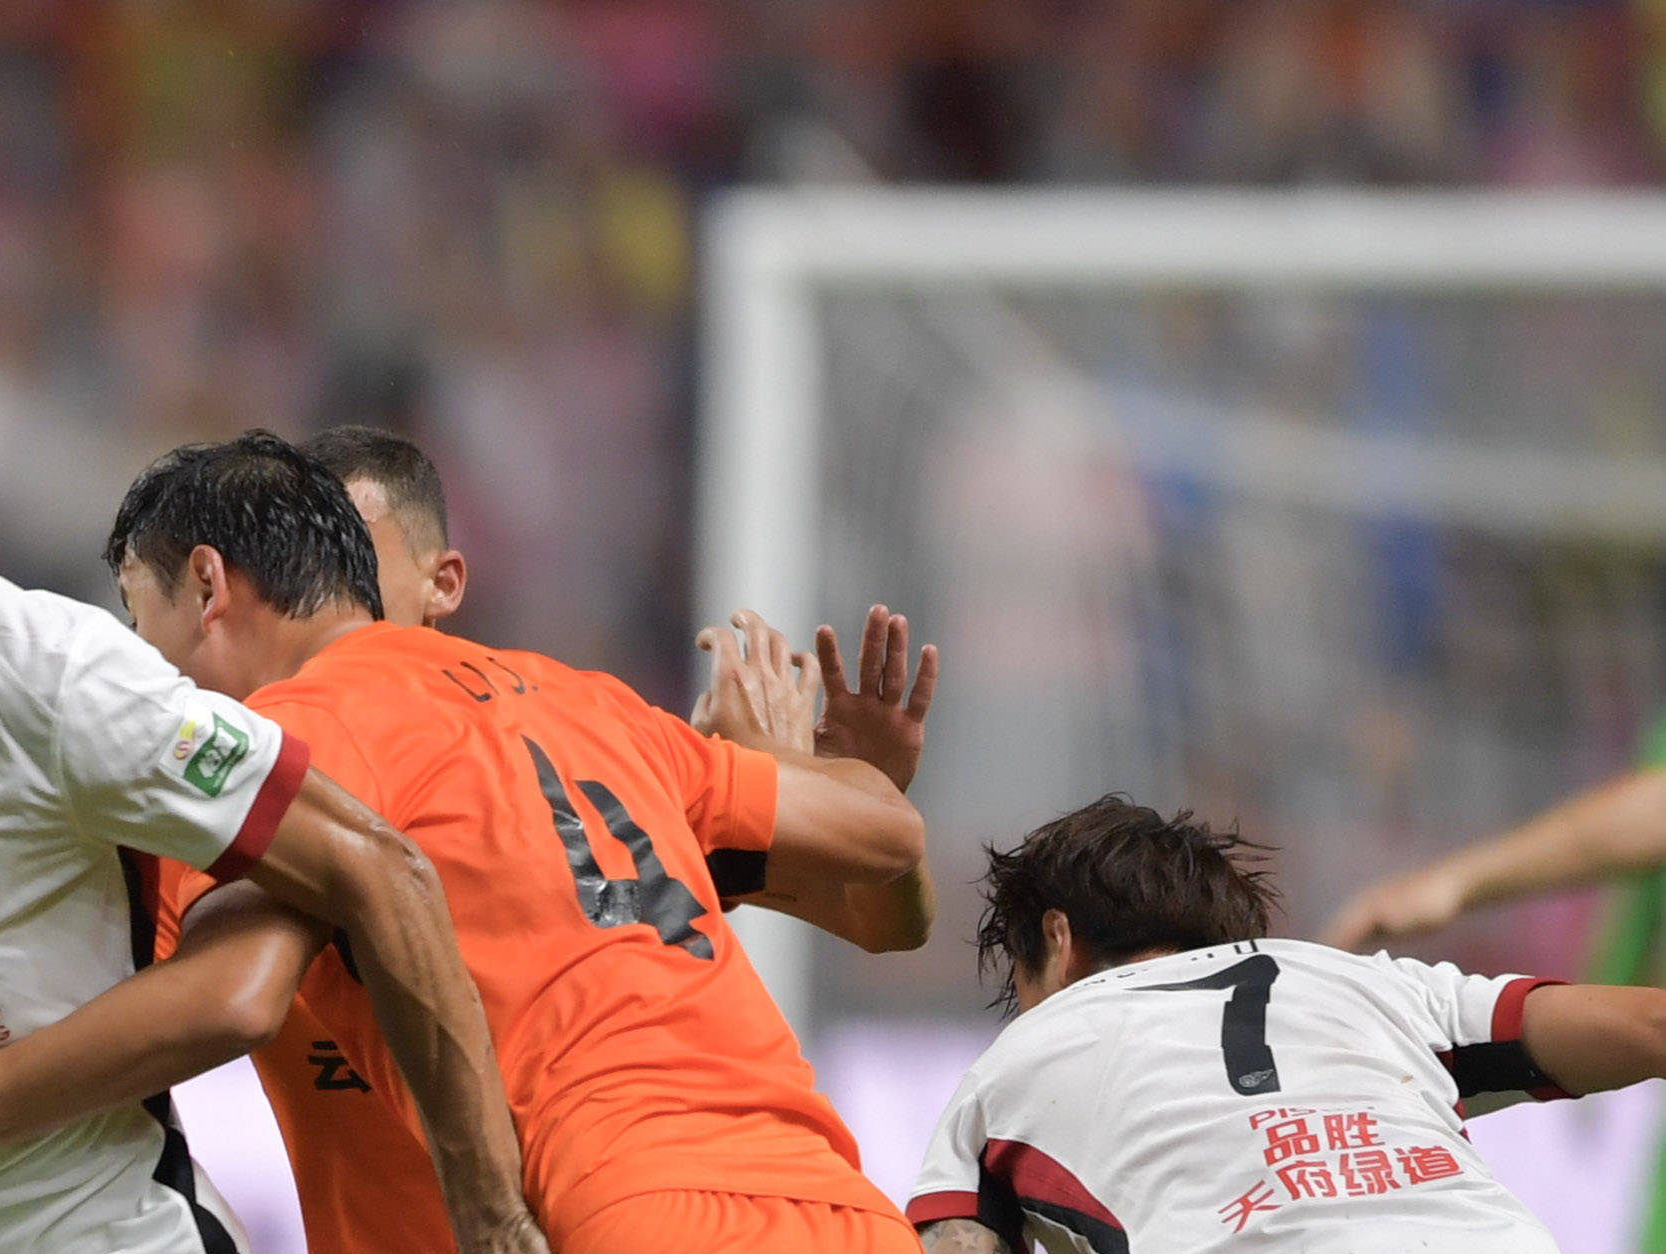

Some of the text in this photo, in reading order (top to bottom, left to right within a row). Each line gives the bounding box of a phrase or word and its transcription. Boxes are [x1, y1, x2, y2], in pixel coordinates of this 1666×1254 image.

[520, 733, 716, 961] 4
[306, 1040, 373, 1095] 云
[1121, 953, 1281, 1096] 7
[1263, 1112, 1386, 1167] 品胜
[1217, 1145, 1465, 1234] 天府绿道
